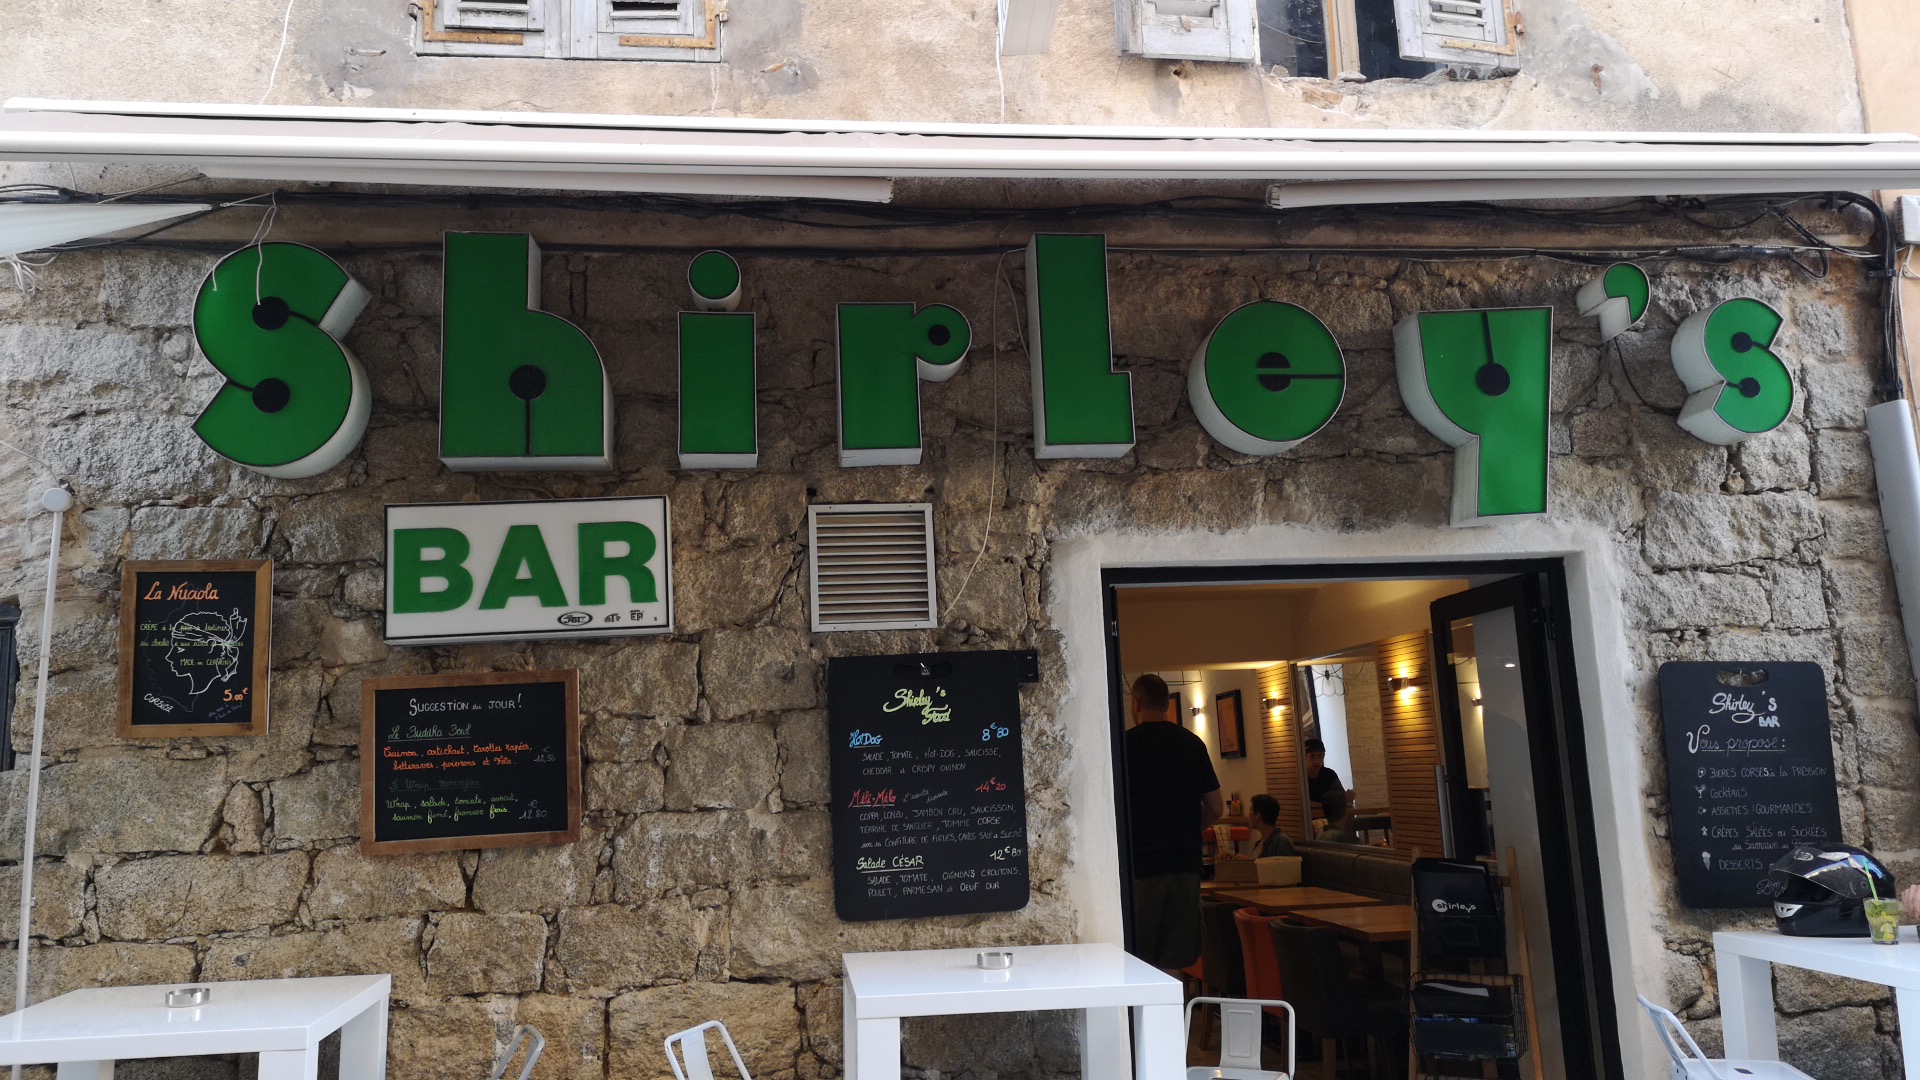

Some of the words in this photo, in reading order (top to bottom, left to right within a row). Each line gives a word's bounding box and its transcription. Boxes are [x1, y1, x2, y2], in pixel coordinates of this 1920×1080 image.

[192, 232, 1796, 518] Shirley's
[392, 520, 659, 614] BAR
[143, 581, 162, 600] La
[409, 698, 469, 716] SUGGESTION
[1758, 715, 1780, 728] BAR
[406, 725, 443, 739] Buddha
[1686, 724, 1720, 754] Vous
[441, 759, 476, 770] poivrons
[482, 758, 490, 766] et
[862, 766, 893, 776] CHEDDAR
[912, 764, 936, 774] CRISPY
[940, 762, 966, 772] OIGNON
[1740, 766, 1769, 778] CORSES
[1792, 765, 1828, 777] PRESSION
[392, 811, 422, 822] saumon
[454, 806, 484, 822] fromage
[912, 808, 943, 818] JAMBON
[1711, 805, 1750, 816] ASSIETTES
[1755, 803, 1814, 816] GOURMANDES
[859, 824, 887, 835] TERRINE
[892, 823, 900, 832] DE
[942, 818, 970, 829] TOMME
[977, 816, 1001, 826] CORSE
[1791, 824, 1828, 838] SUCRÉES
[884, 835, 918, 848] CONFITURE
[920, 834, 929, 844] DE
[856, 856, 886, 870] Salade
[892, 854, 924, 868] CÉSAR
[1718, 854, 1763, 870] DESSERTS
[942, 869, 976, 881] OIGNONS
[902, 884, 944, 896] PARMESAN
[960, 882, 980, 892] OEUF
[985, 880, 1000, 890] DUR
